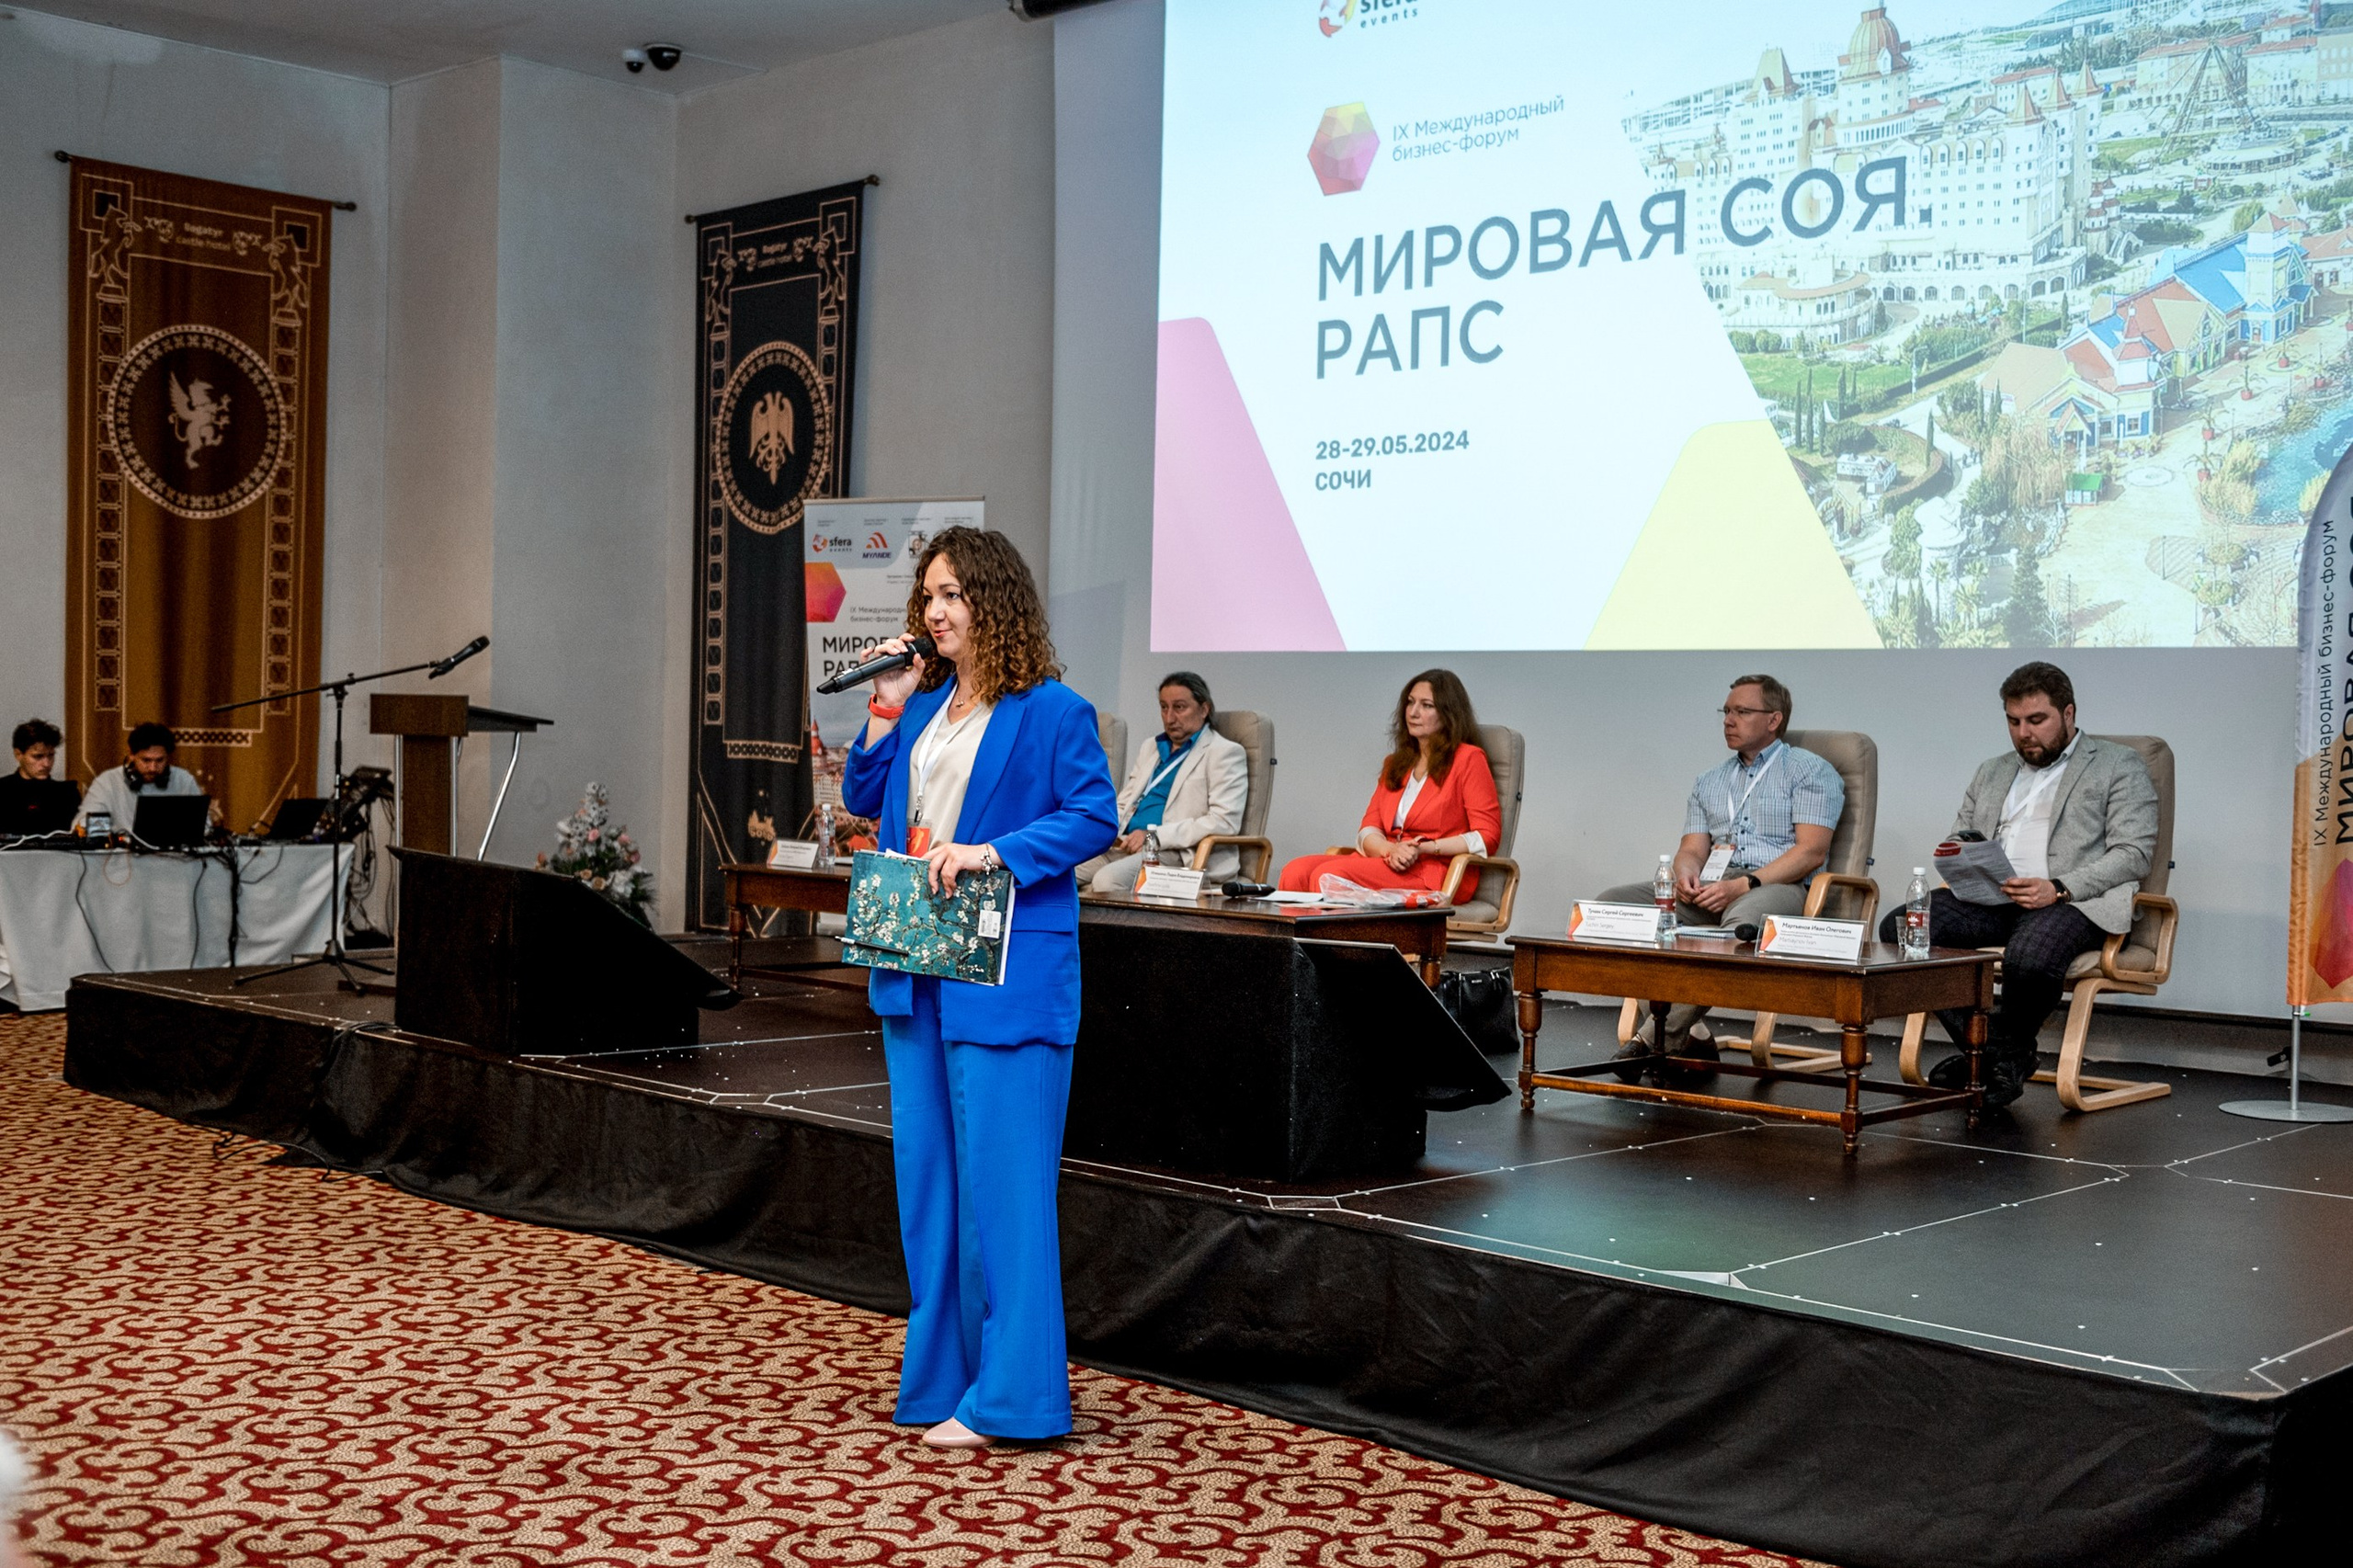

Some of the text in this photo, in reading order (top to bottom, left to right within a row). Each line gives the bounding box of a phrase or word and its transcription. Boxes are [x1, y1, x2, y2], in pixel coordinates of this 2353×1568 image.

[1360, 8, 1418, 28] events
[1415, 95, 1564, 136] Международный
[1392, 128, 1519, 162] бизнес-форум
[1317, 188, 1688, 302] МИРОВАЯ
[1315, 299, 1505, 380] РАПС
[1315, 429, 1470, 460] 28-29.05.2024
[1314, 469, 1371, 492] СОЧИ
[829, 536, 852, 546] sfera
[2318, 519, 2337, 657] бизнес-форум
[2315, 664, 2334, 821] Международный
